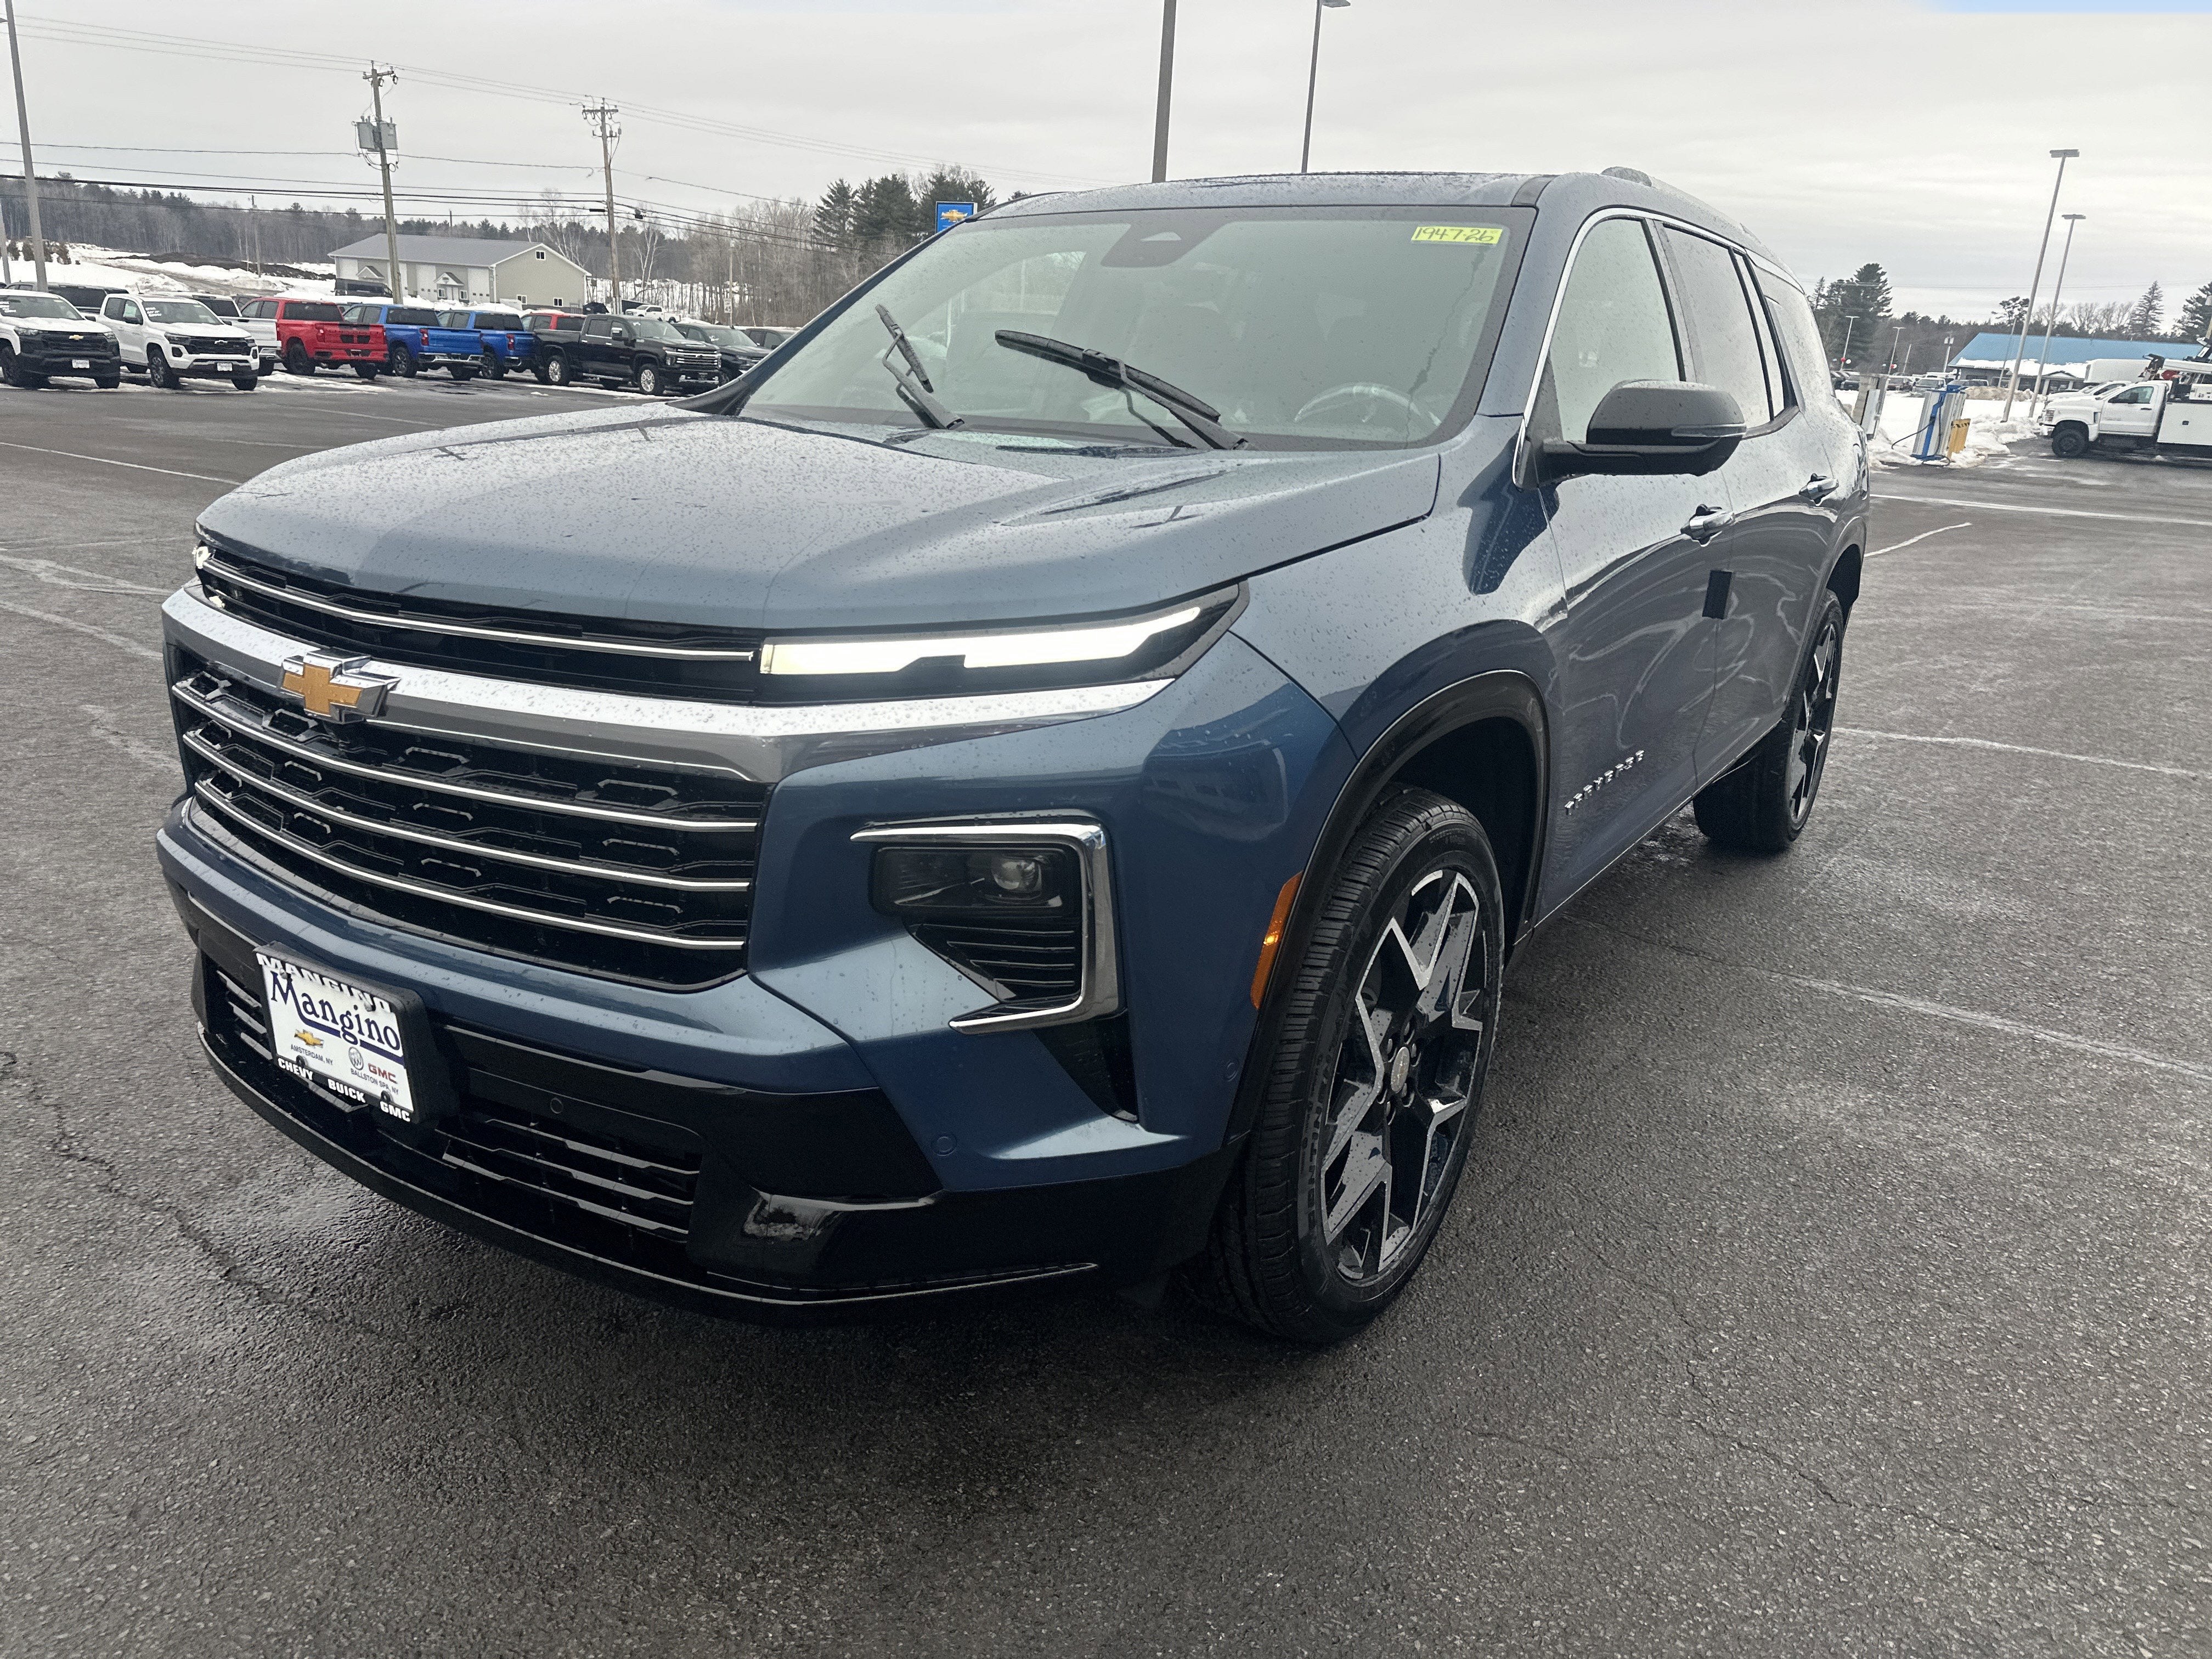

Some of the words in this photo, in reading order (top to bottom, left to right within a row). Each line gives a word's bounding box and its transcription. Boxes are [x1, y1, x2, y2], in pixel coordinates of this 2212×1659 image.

[270, 970, 402, 1052] Mangino
[290, 1043, 325, 1064] AMSTERDAM,
[325, 1057, 333, 1066] NY
[350, 1068, 378, 1086] BALLSTON
[368, 1063, 398, 1085] GMC
[277, 1057, 313, 1081] CHEVY
[327, 1078, 366, 1103] BUICK
[380, 1101, 411, 1122] GMC
